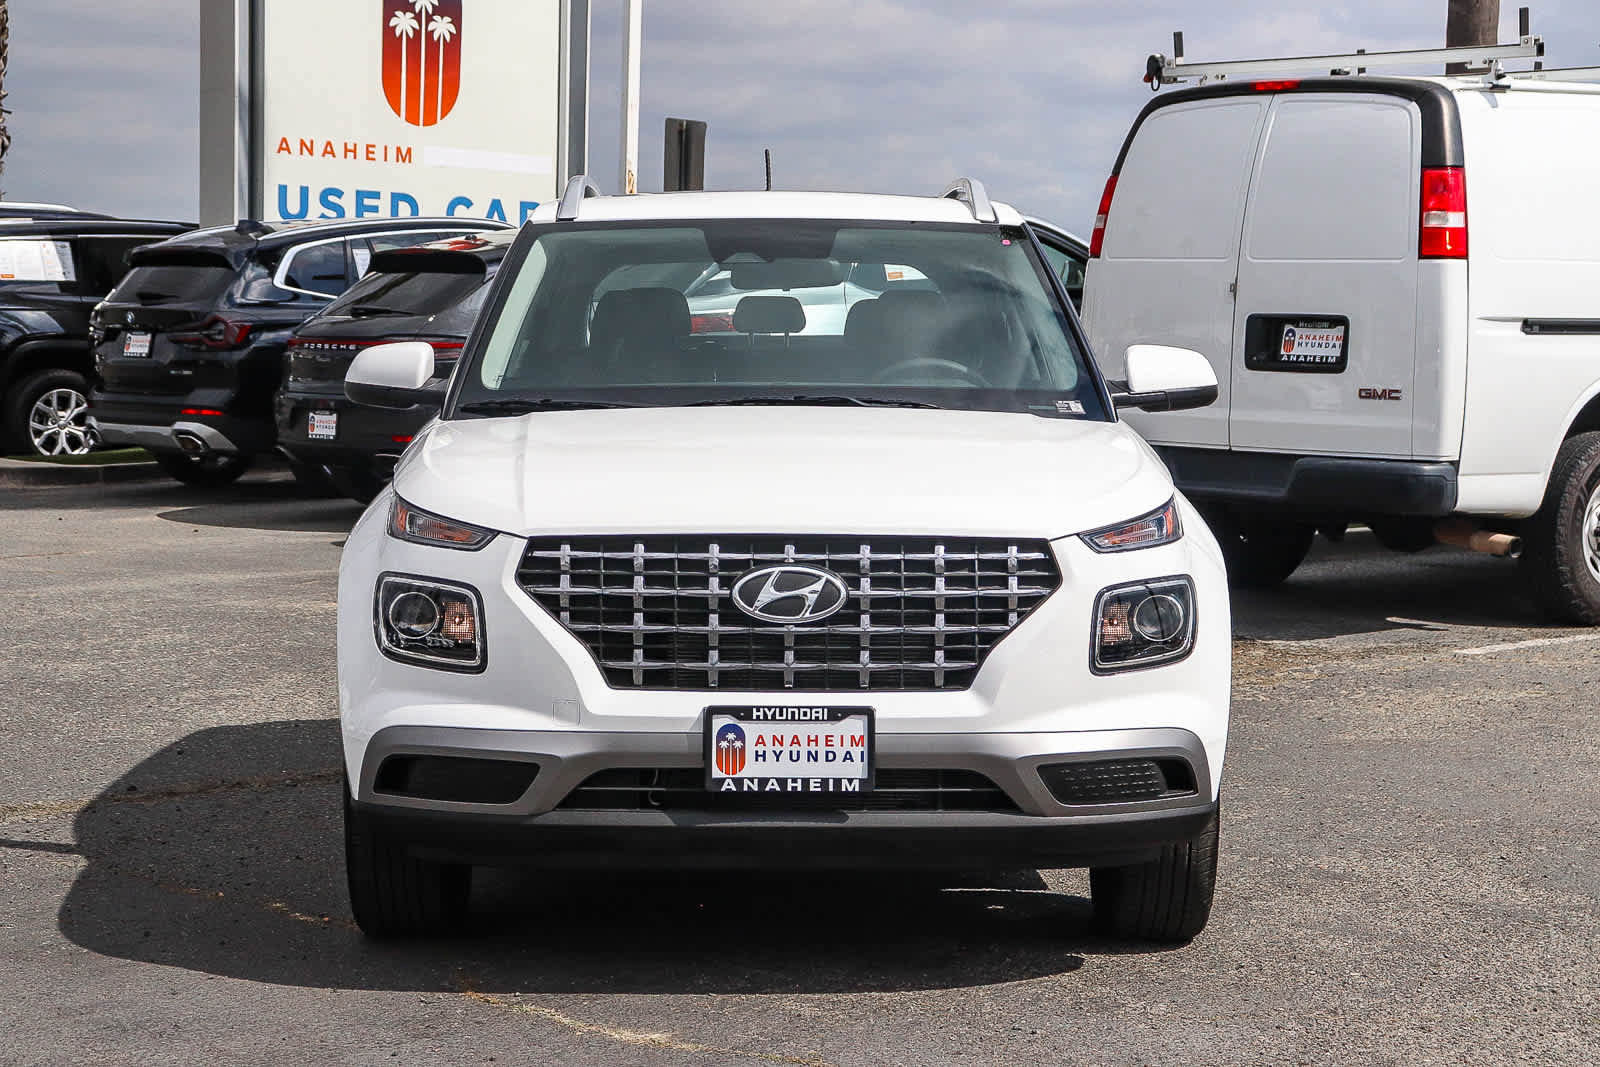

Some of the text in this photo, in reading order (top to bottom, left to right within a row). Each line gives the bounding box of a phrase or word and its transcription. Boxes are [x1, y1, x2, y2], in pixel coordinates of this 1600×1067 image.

[277, 137, 412, 163] ANAHEIM
[278, 184, 419, 224] USED
[1298, 333, 1344, 342] ANAHEIM
[1297, 341, 1342, 349] HYUNDAI
[1281, 354, 1337, 363] ANAHEIM
[1358, 388, 1402, 400] GMC
[752, 707, 828, 720] HYUNDAI
[754, 734, 865, 747] ANAHEIM
[754, 750, 865, 763] HYUNDAI
[720, 778, 860, 792] ANAHEIM
